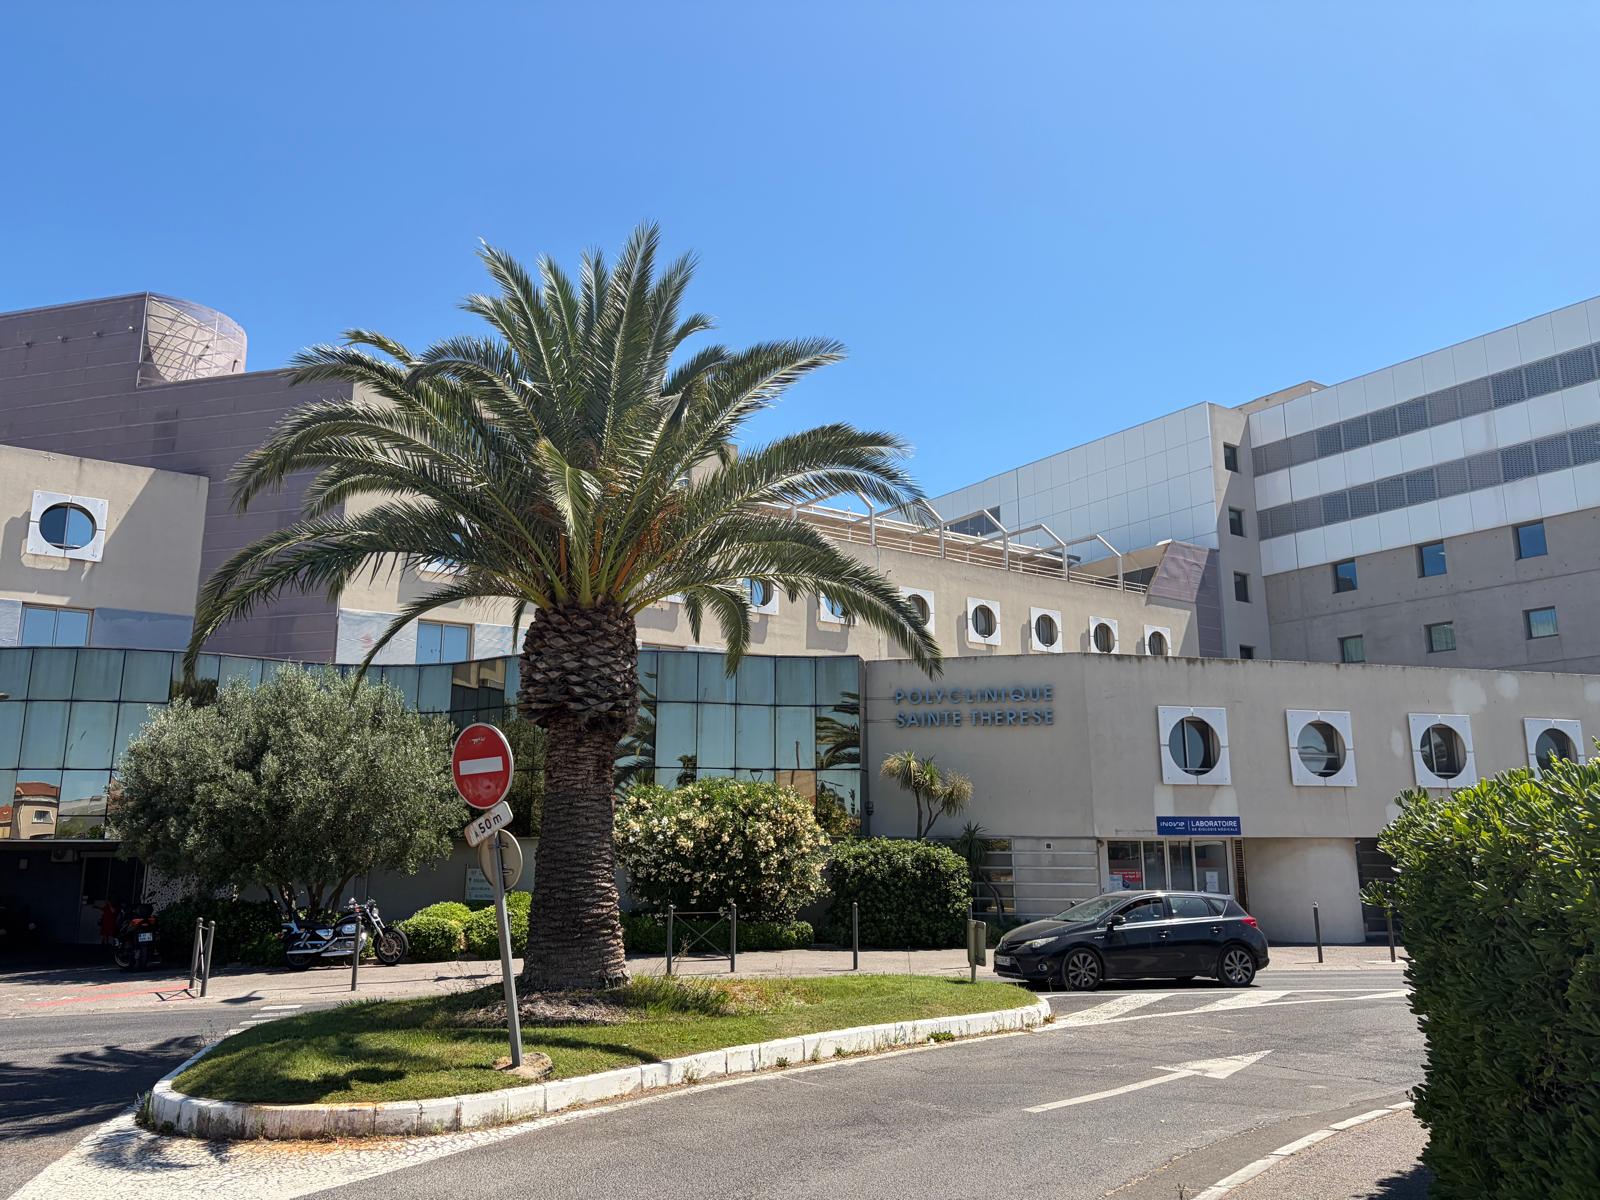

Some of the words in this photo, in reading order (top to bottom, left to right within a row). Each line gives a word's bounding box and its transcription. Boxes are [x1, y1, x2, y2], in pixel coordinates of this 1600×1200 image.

[895, 684, 1055, 705] POLYCLINIQUE
[896, 709, 962, 728] SAINTE
[970, 708, 1055, 726] THERESE
[478, 818, 492, 834] 50
[493, 814, 503, 825] m
